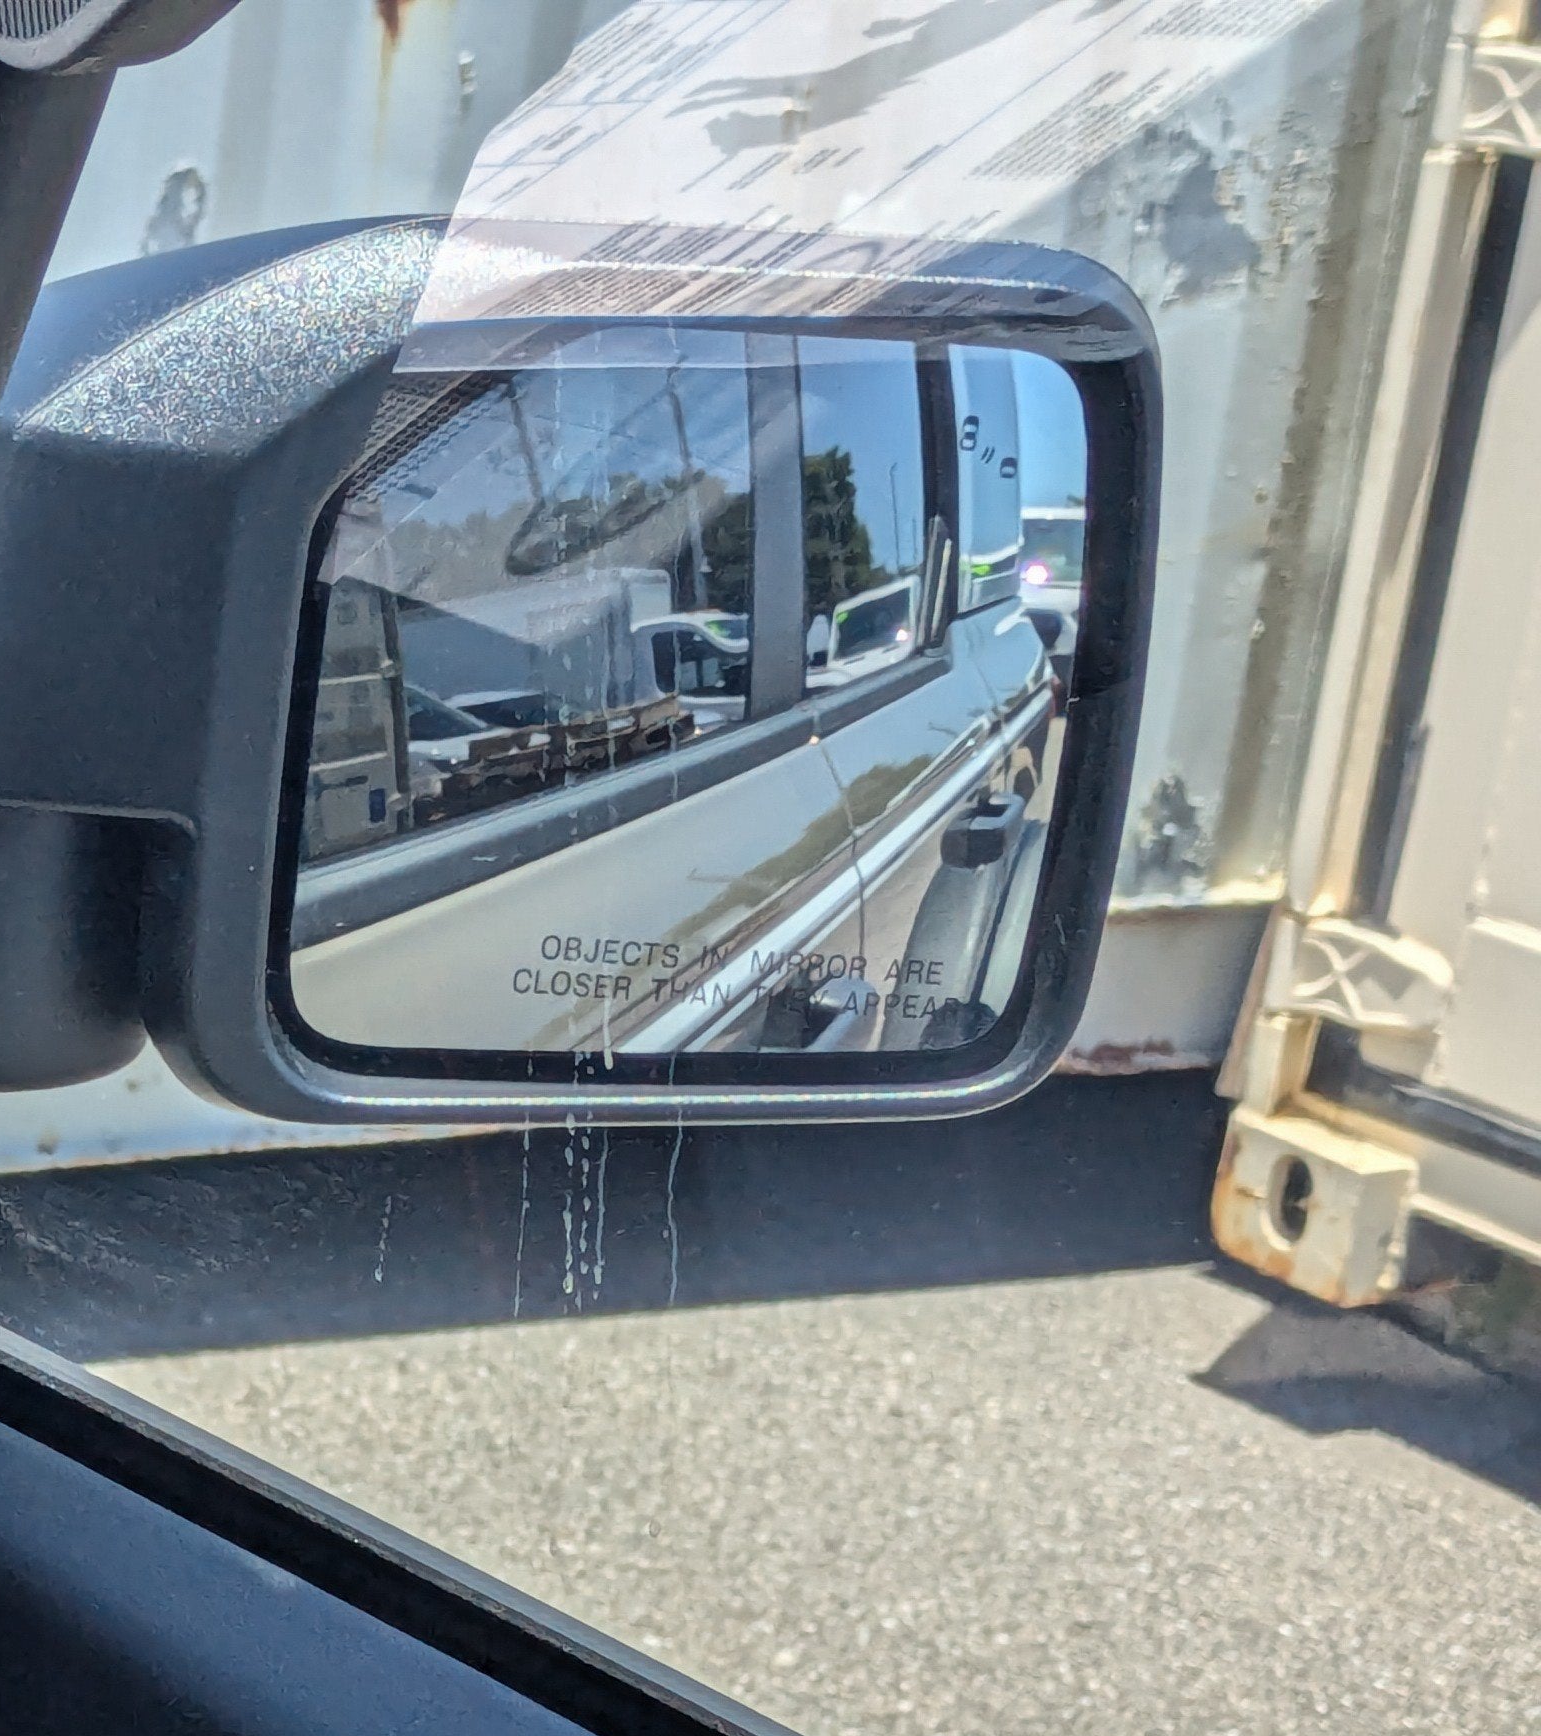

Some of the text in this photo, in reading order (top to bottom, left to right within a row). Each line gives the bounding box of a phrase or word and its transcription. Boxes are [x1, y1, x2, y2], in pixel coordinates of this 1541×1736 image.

[541, 934, 944, 985] OBJECTS IN MIRROR ARE
[512, 967, 632, 1001] CLOSER
[651, 977, 731, 1006] THAN
[842, 993, 961, 1020] APPEAR
